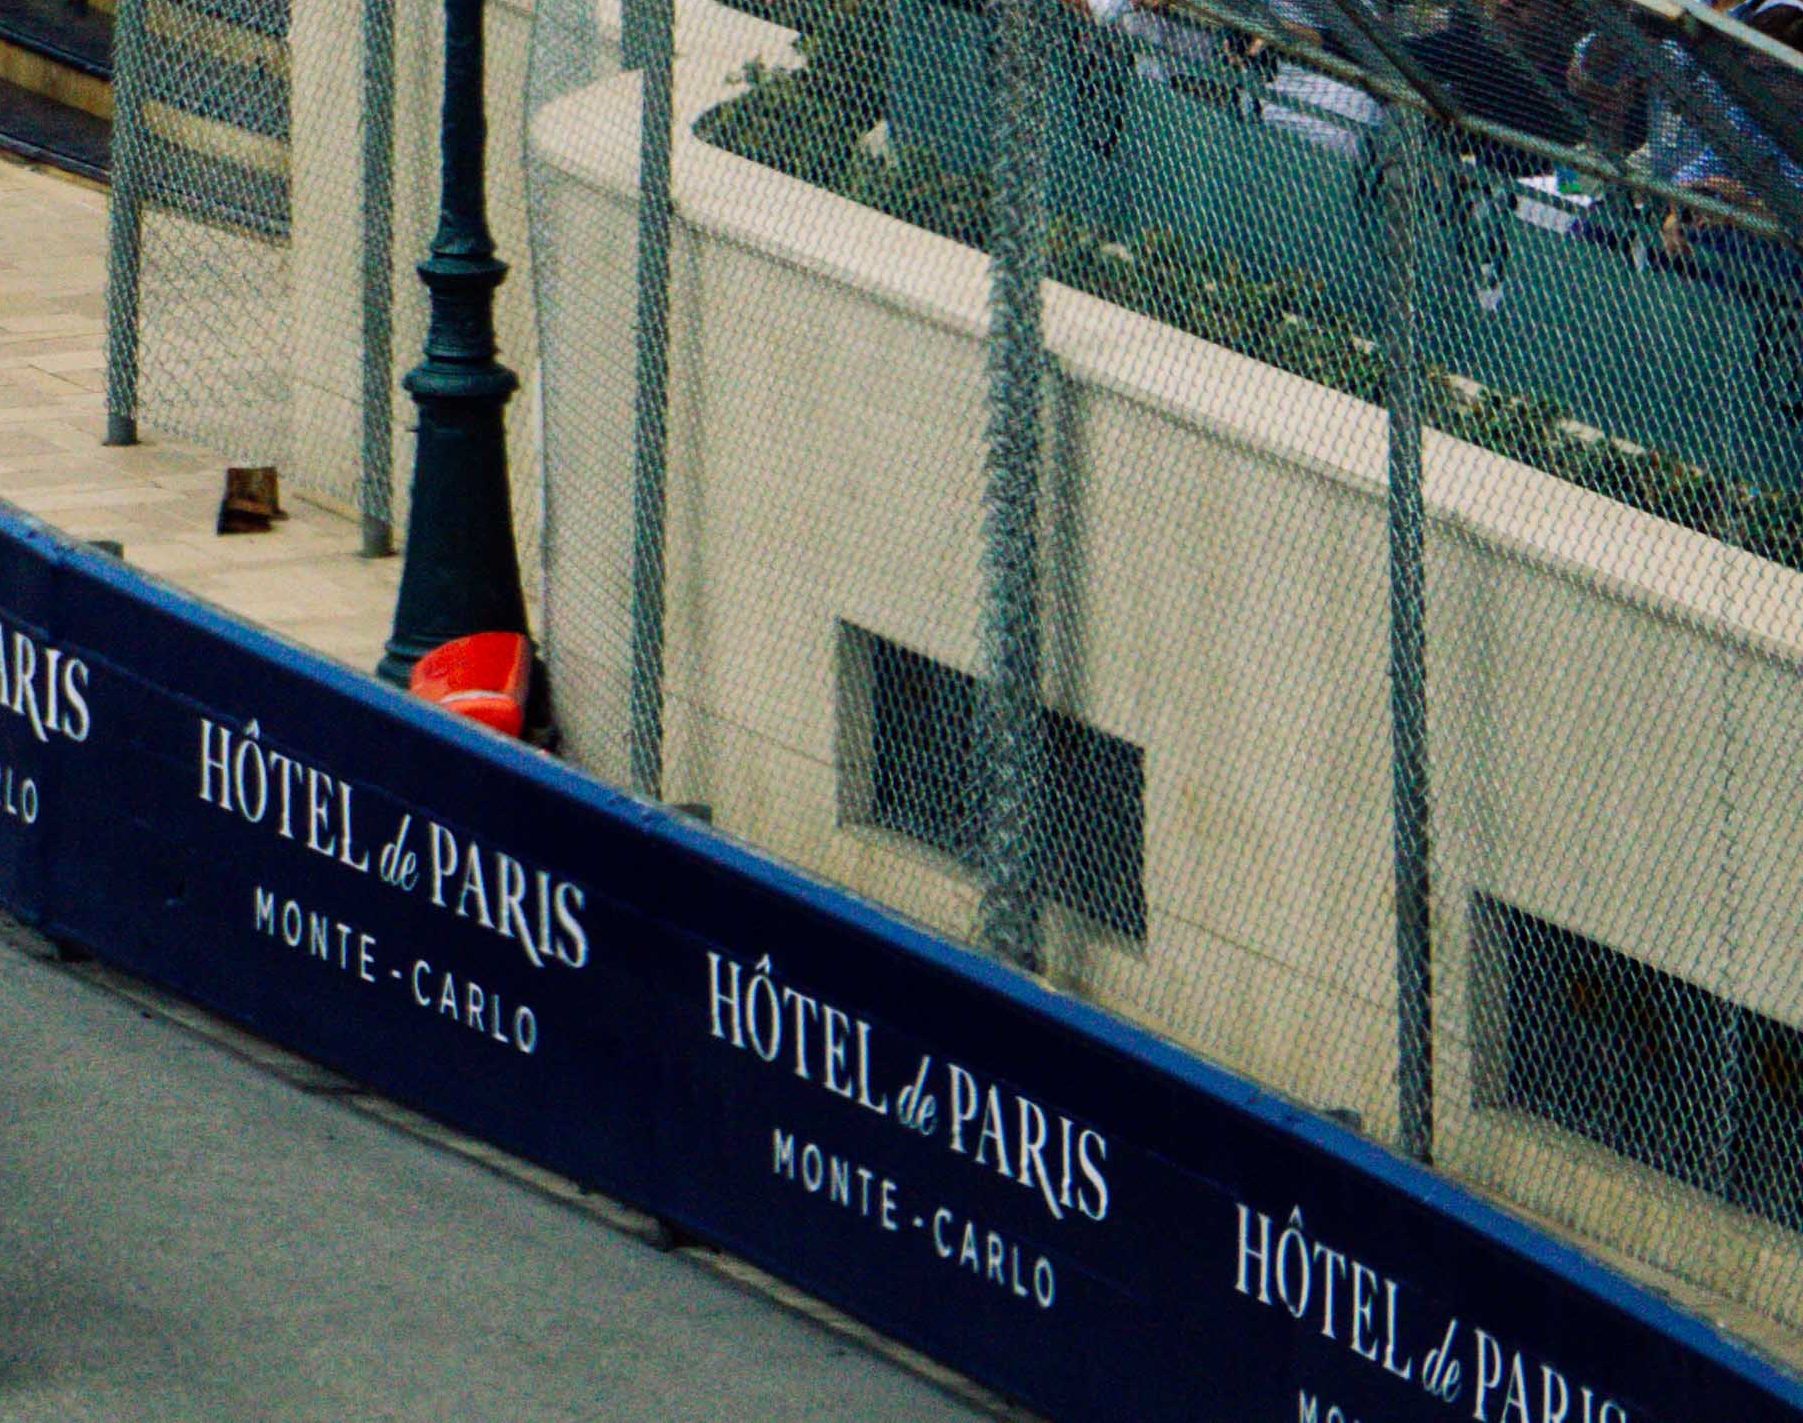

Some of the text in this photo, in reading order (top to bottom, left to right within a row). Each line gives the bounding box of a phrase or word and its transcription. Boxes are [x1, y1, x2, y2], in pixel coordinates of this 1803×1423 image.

[198, 716, 590, 970] HÔTEL de PARIS
[255, 885, 538, 1056] MONTE-CARLO
[706, 950, 1111, 1223] HÔTEL de PARIS
[773, 1128, 1058, 1310] MONTE-CARLO
[1235, 1202, 1412, 1381] HÔTEL
[1421, 1318, 1463, 1403] de
